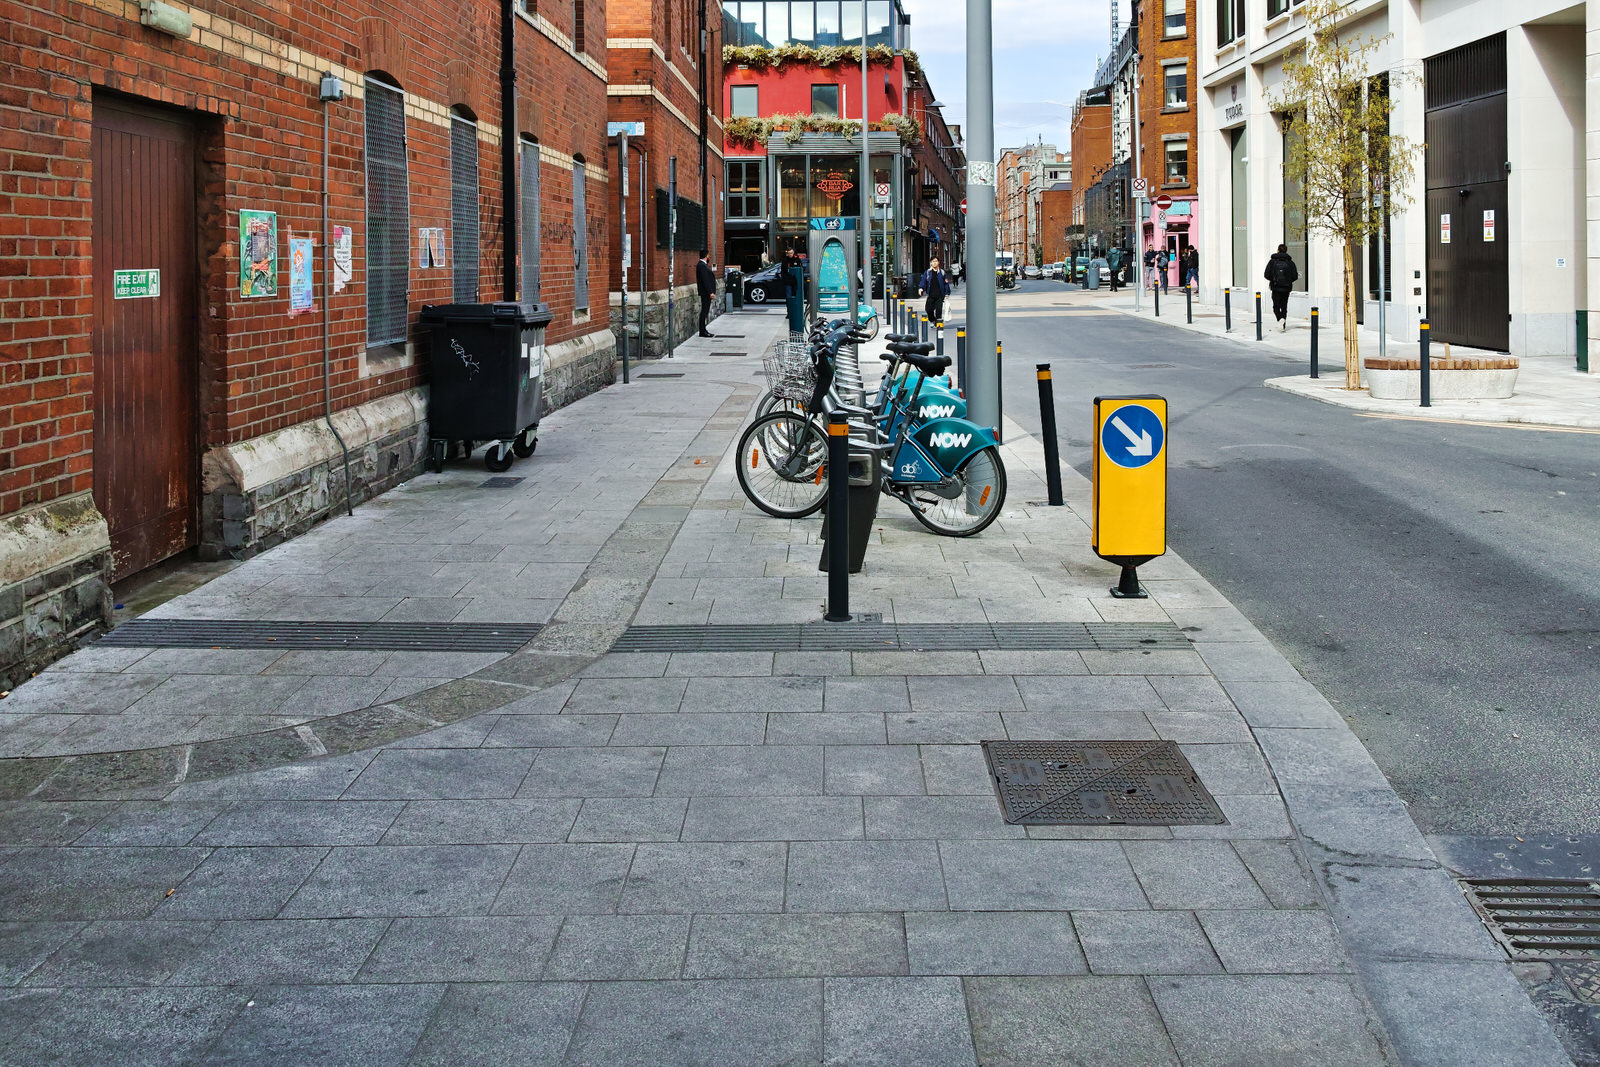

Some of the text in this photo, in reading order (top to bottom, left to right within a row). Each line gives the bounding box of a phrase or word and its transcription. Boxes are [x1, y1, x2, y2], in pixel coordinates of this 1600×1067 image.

[117, 274, 146, 285] FIRE EXIT
[117, 286, 147, 295] KEEP CLEAR
[919, 404, 956, 418] NOW
[929, 432, 973, 448] NOW
